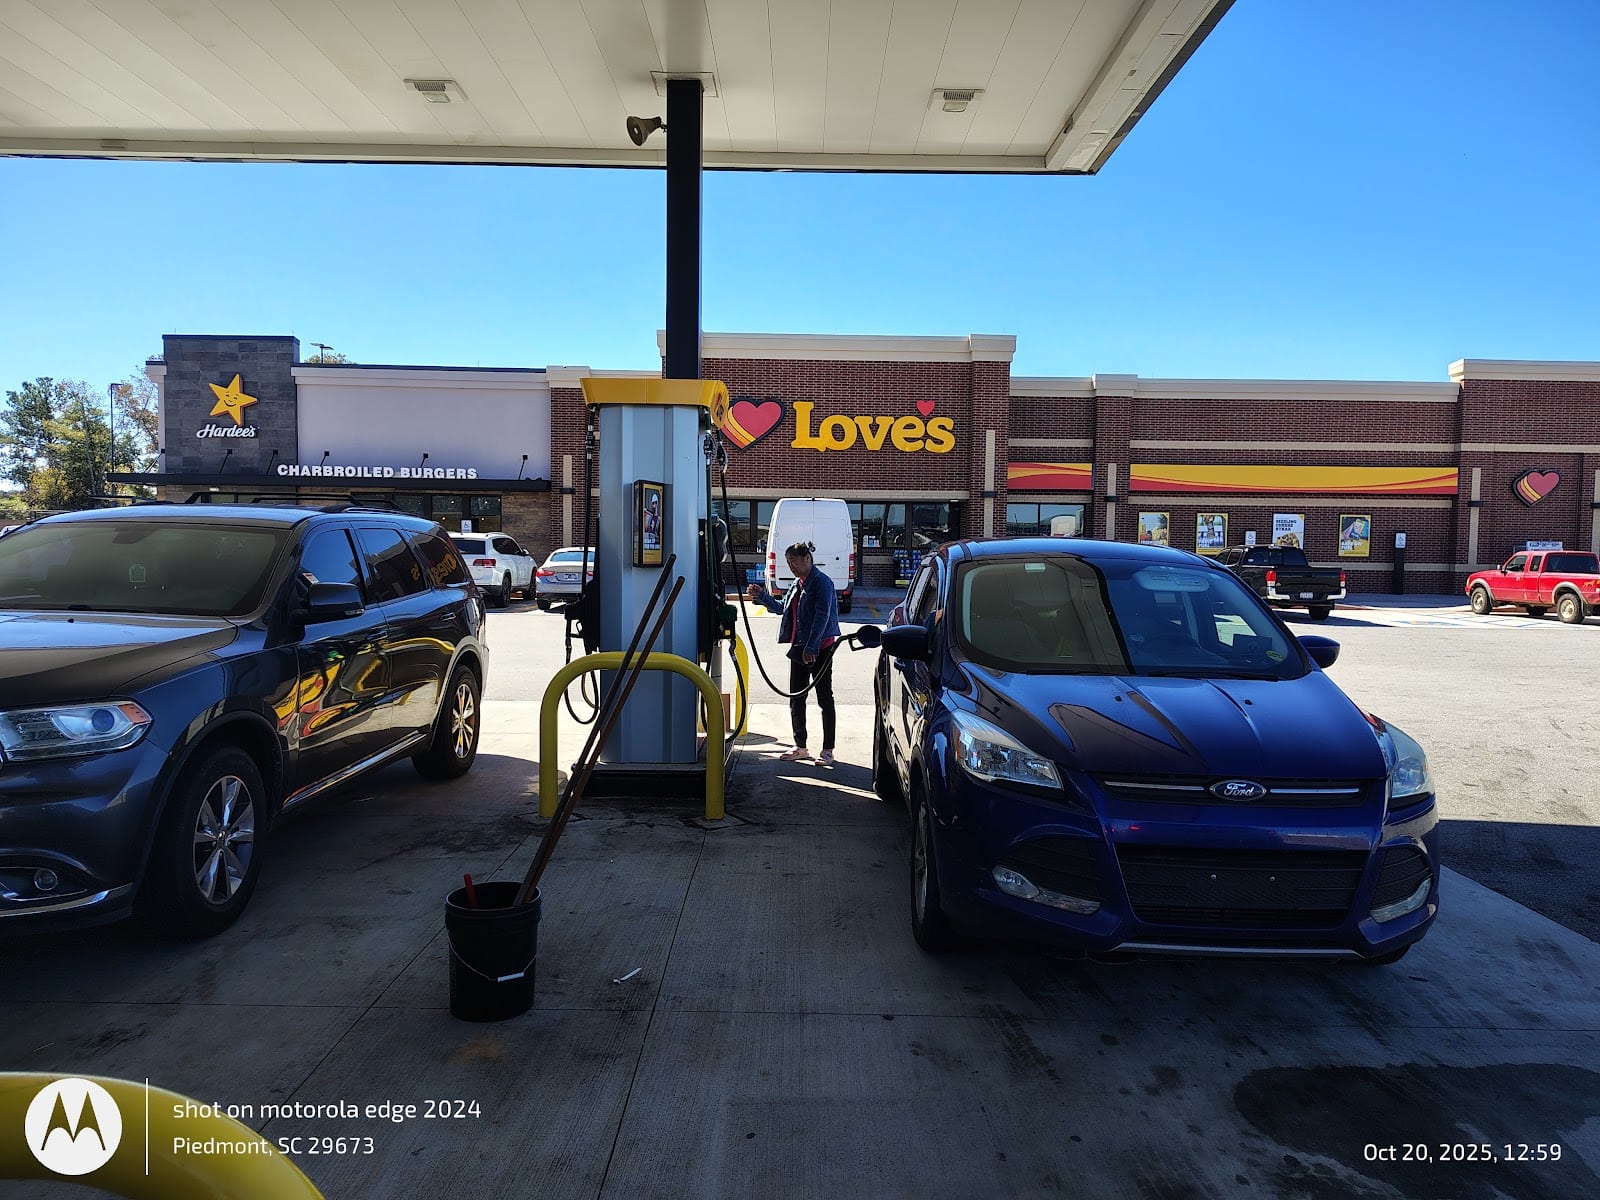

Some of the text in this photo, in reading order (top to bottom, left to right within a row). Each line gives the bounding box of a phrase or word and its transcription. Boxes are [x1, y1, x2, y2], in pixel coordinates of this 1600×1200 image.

[196, 423, 257, 438] Hardee's
[277, 464, 478, 479] CHARBROILED BURGERS
[1224, 782, 1255, 797] Ford
